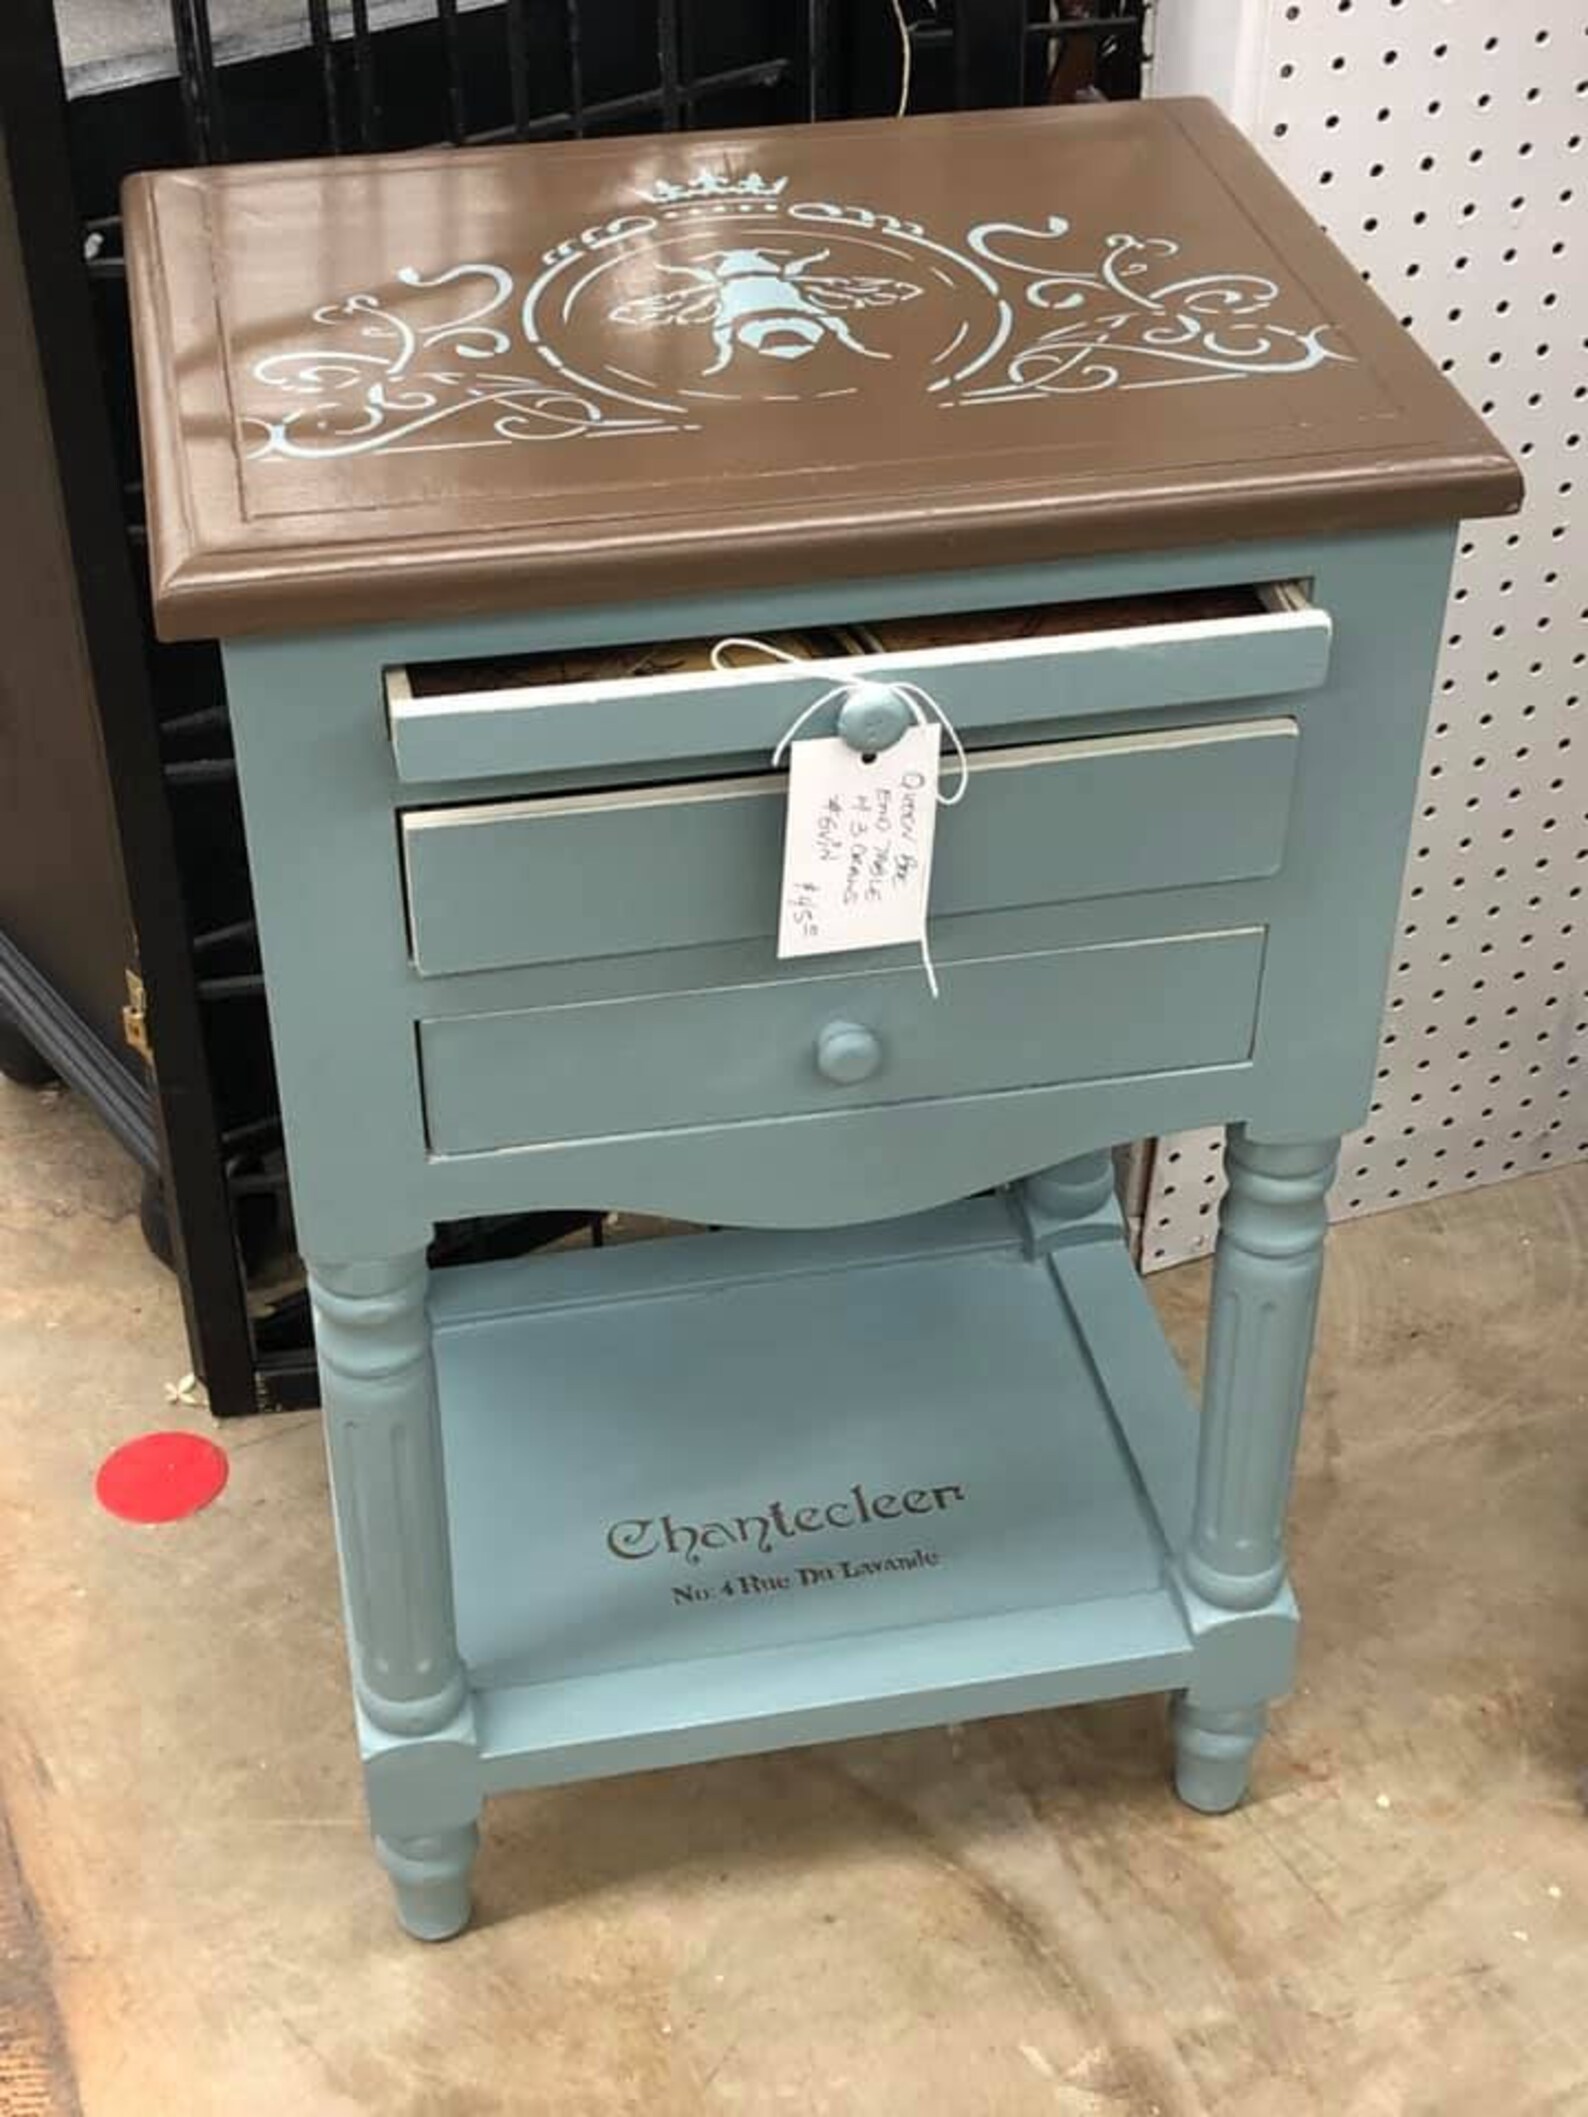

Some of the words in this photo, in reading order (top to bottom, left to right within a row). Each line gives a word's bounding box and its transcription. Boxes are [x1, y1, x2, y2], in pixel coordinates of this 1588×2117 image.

[606, 1484, 965, 1565] Chantecleer
[737, 1574, 790, 1595] Rue
[797, 1567, 834, 1587] Du
[839, 1549, 940, 1578] Lavande
